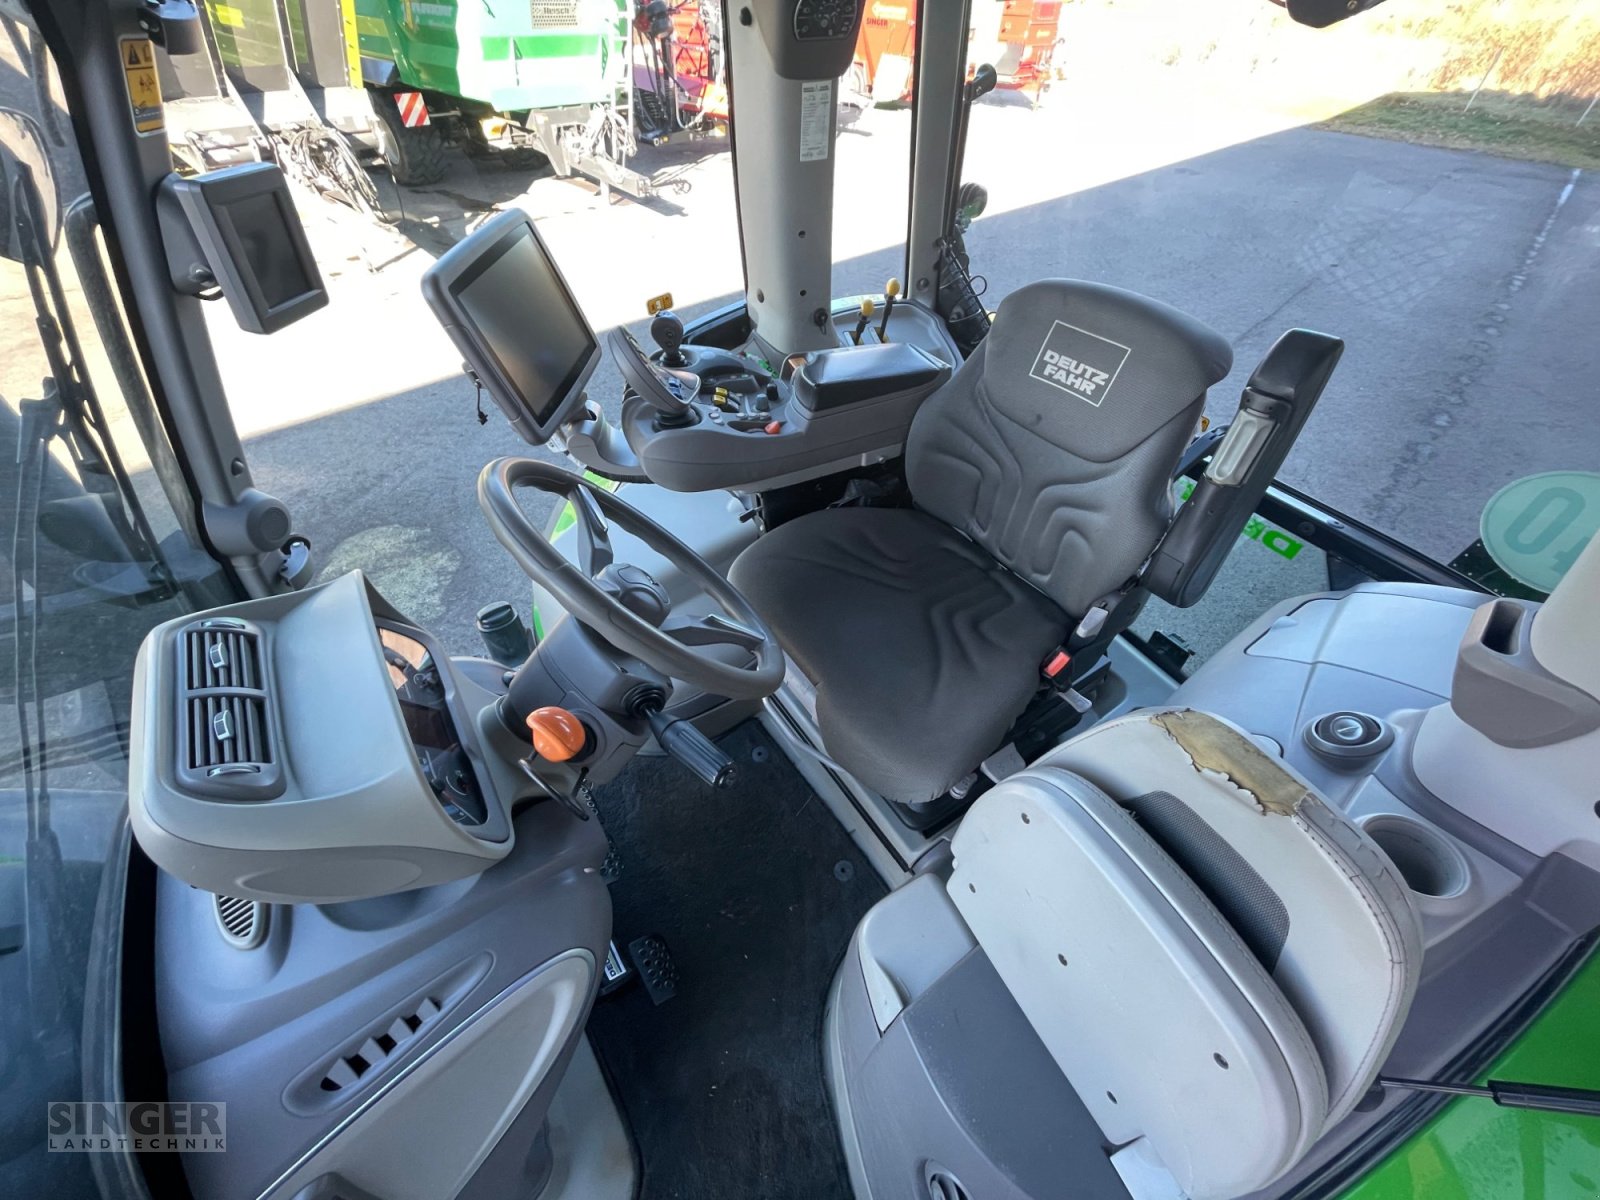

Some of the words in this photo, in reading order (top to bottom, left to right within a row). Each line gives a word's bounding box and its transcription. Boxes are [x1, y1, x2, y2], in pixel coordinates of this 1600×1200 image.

[866, 17, 888, 27] SINGER
[1043, 349, 1109, 386] DEUTZ
[1043, 364, 1096, 395] FAHR
